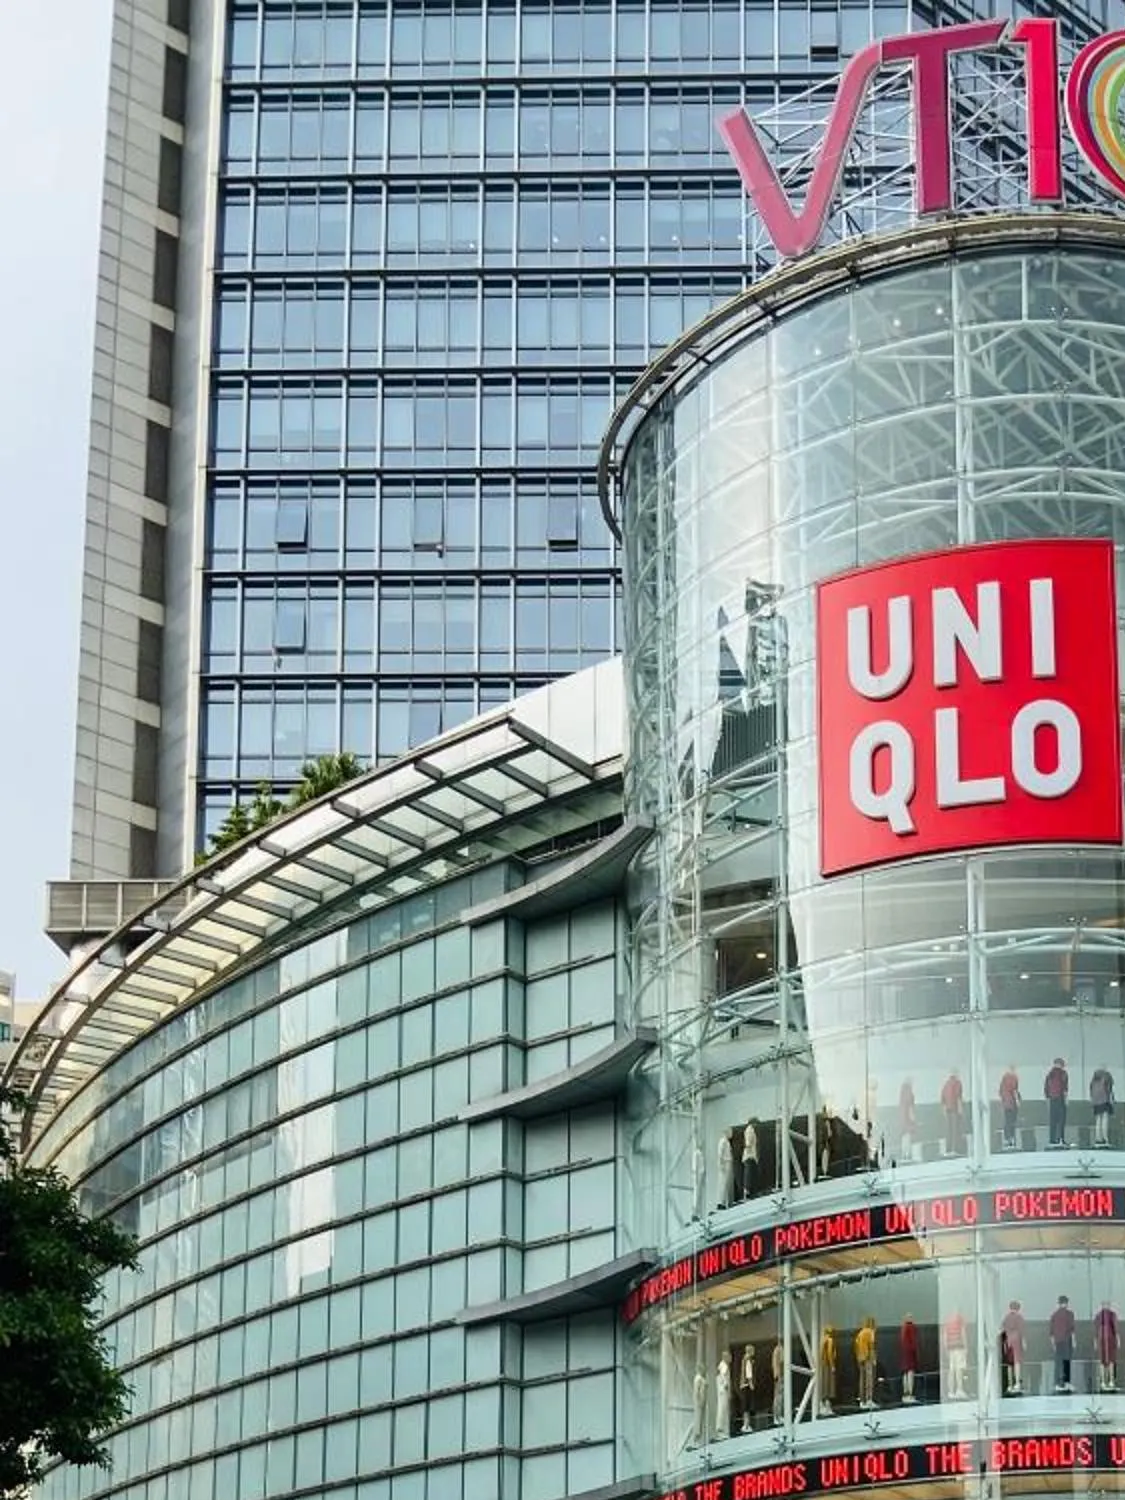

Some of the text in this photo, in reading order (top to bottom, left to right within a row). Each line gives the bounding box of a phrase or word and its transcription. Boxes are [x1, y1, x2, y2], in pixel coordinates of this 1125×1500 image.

[845, 576, 1059, 701] UNI
[848, 698, 1083, 836] QLO
[699, 1234, 763, 1280] UNIQLO
[775, 1208, 870, 1251] POKEMON
[884, 1196, 978, 1233] UNIQLO
[995, 1188, 1113, 1221] POKEMON
[821, 1448, 909, 1487] UNIQLO
[925, 1442, 973, 1475] THE
[991, 1436, 1094, 1471] BRANDS
